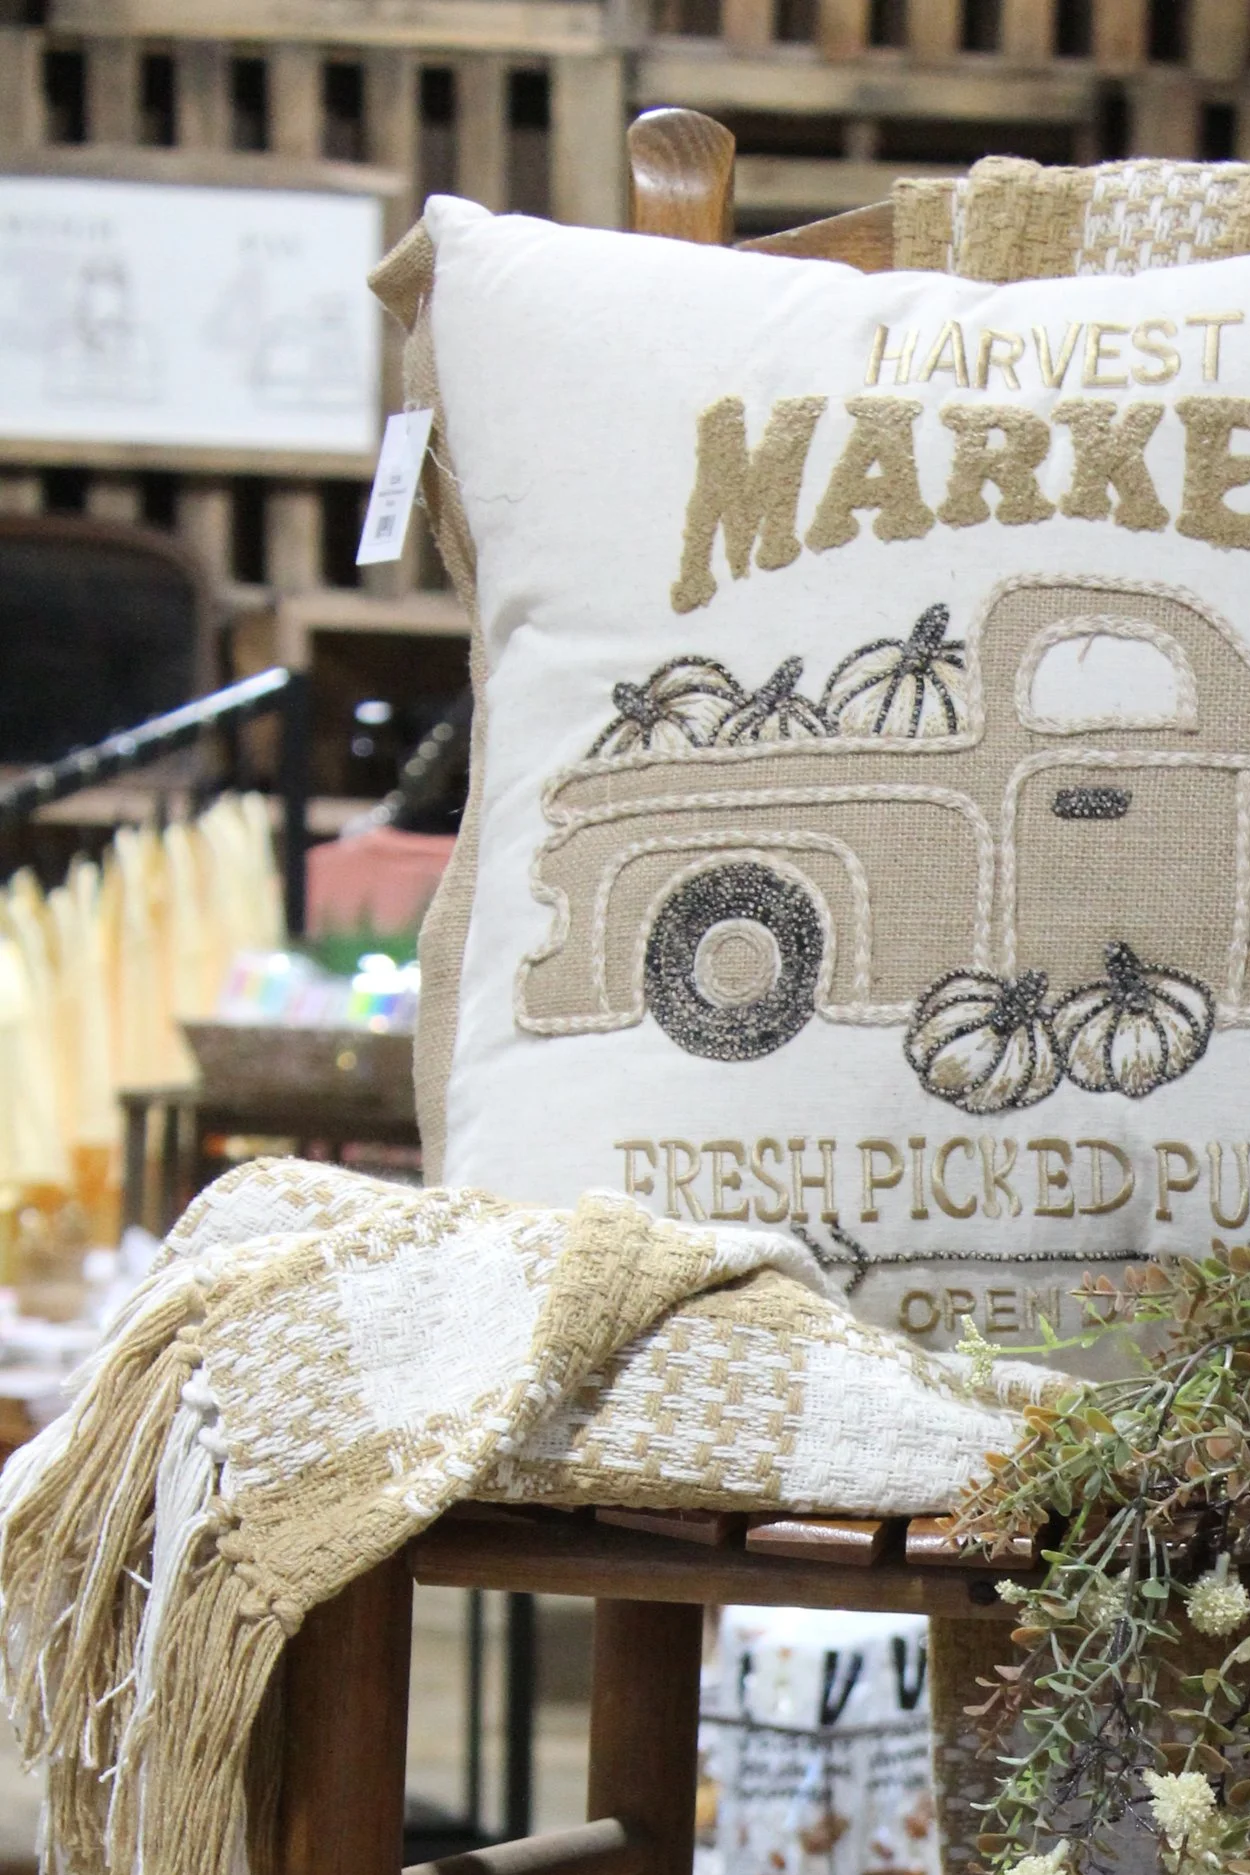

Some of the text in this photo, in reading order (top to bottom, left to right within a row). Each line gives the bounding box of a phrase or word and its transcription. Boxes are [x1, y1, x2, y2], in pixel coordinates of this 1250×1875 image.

[864, 311, 1245, 390] HARVEST
[613, 1136, 837, 1223] FRESH
[857, 1135, 1136, 1220] PICKED
[898, 1286, 1062, 1334] OPEN
